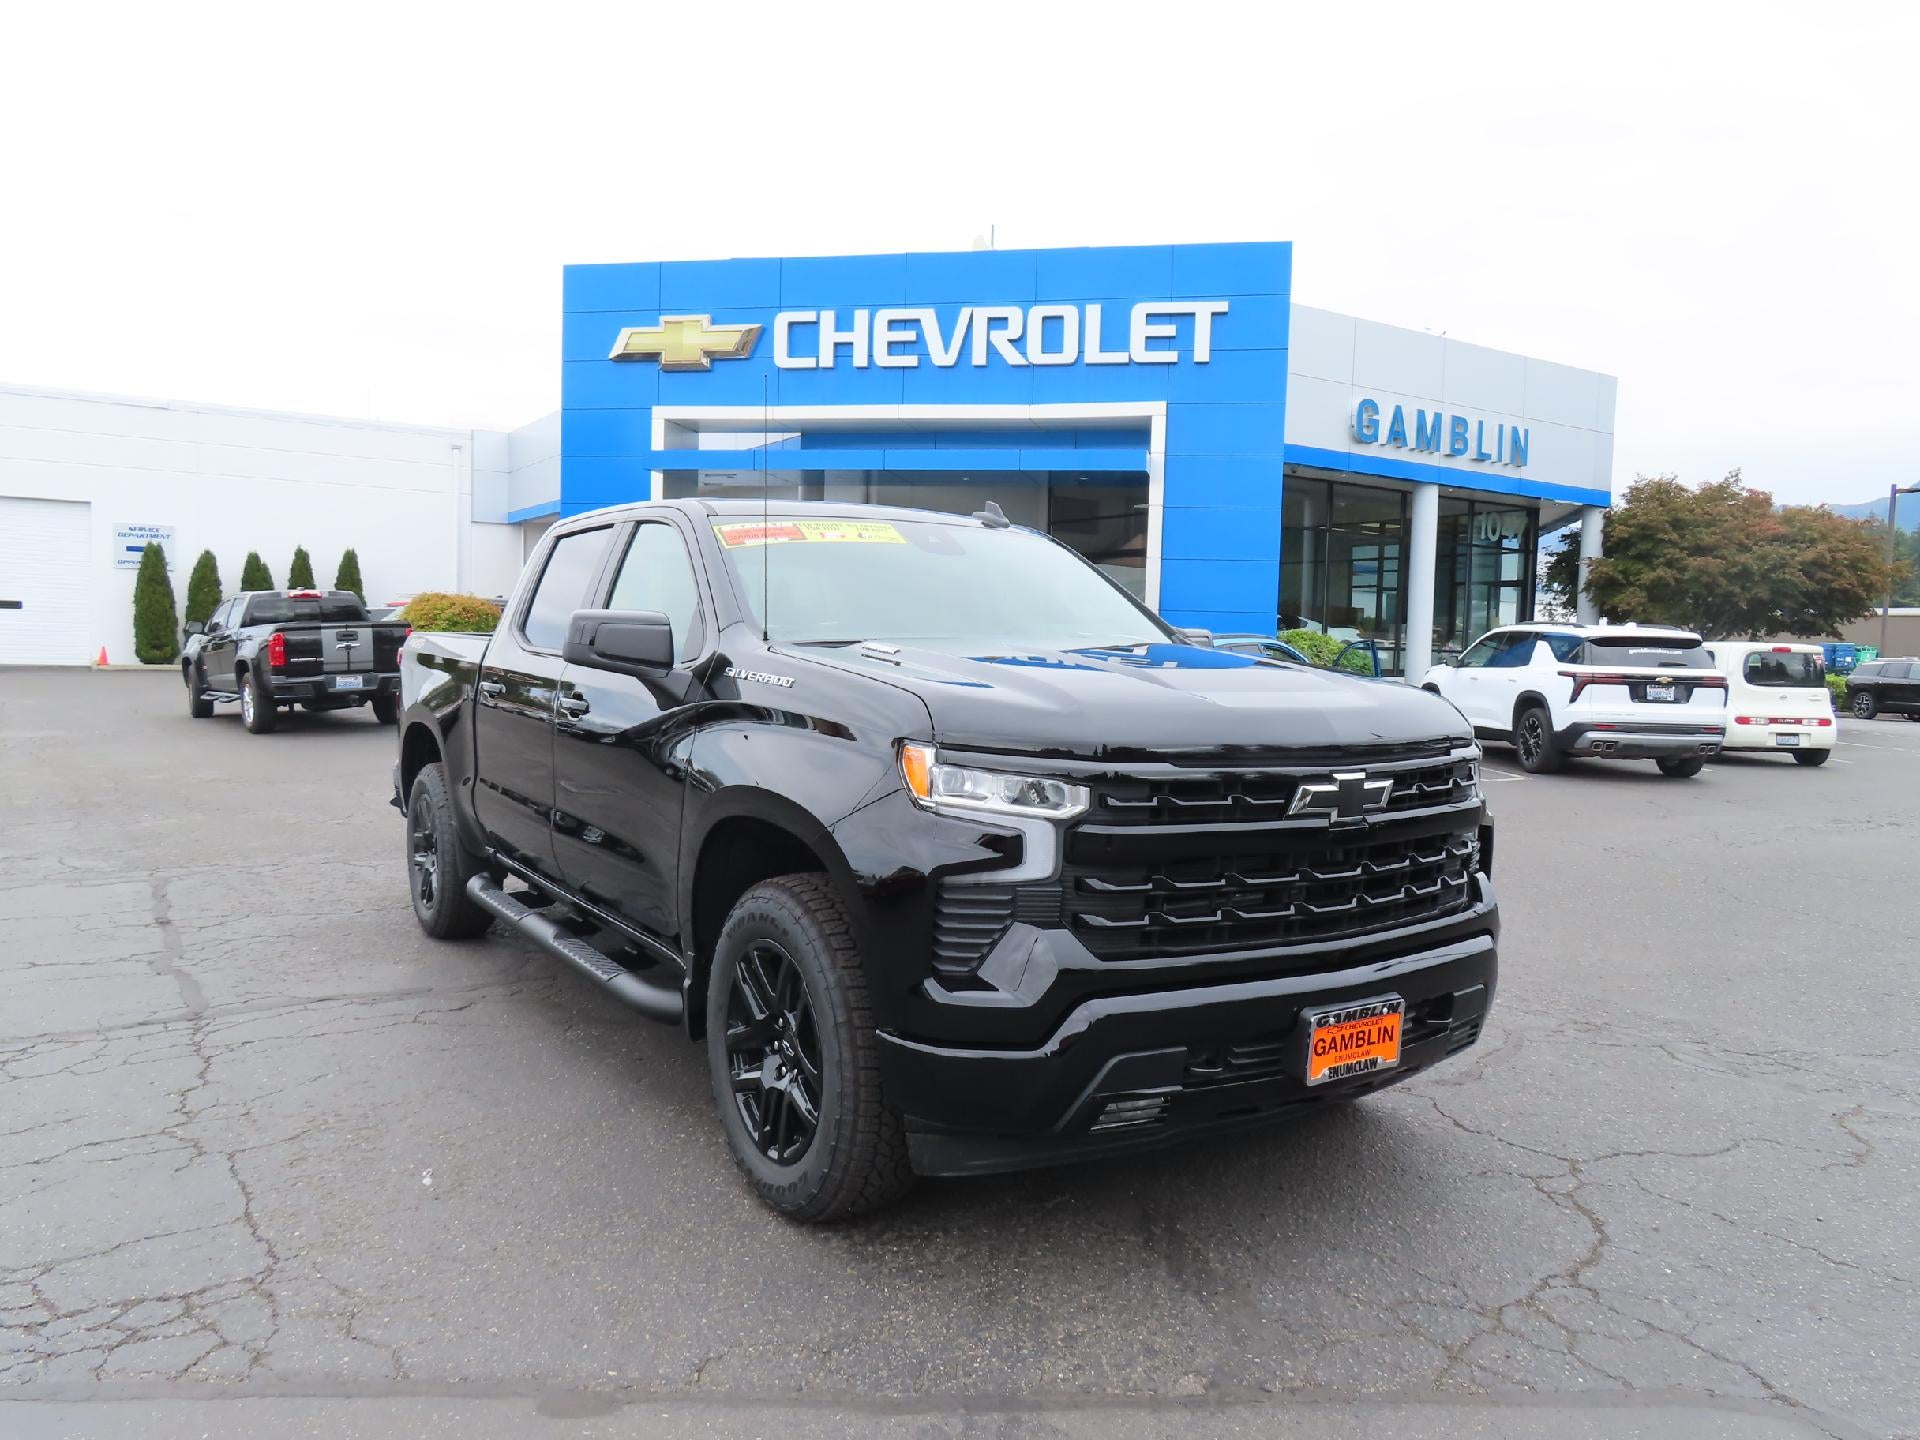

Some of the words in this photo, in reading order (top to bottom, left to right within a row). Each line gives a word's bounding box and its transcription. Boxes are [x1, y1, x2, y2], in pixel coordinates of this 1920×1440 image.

[773, 301, 1229, 368] CHEVROLET
[1355, 398, 1529, 467] GAMBLIN
[724, 666, 795, 688] SILVERADO
[1344, 1018, 1384, 1030] CHEVROLET
[1313, 1025, 1394, 1057] GAMBLIN
[1334, 1049, 1371, 1063] ENUMCLAW
[1328, 1057, 1379, 1079] ENUMCLAW
